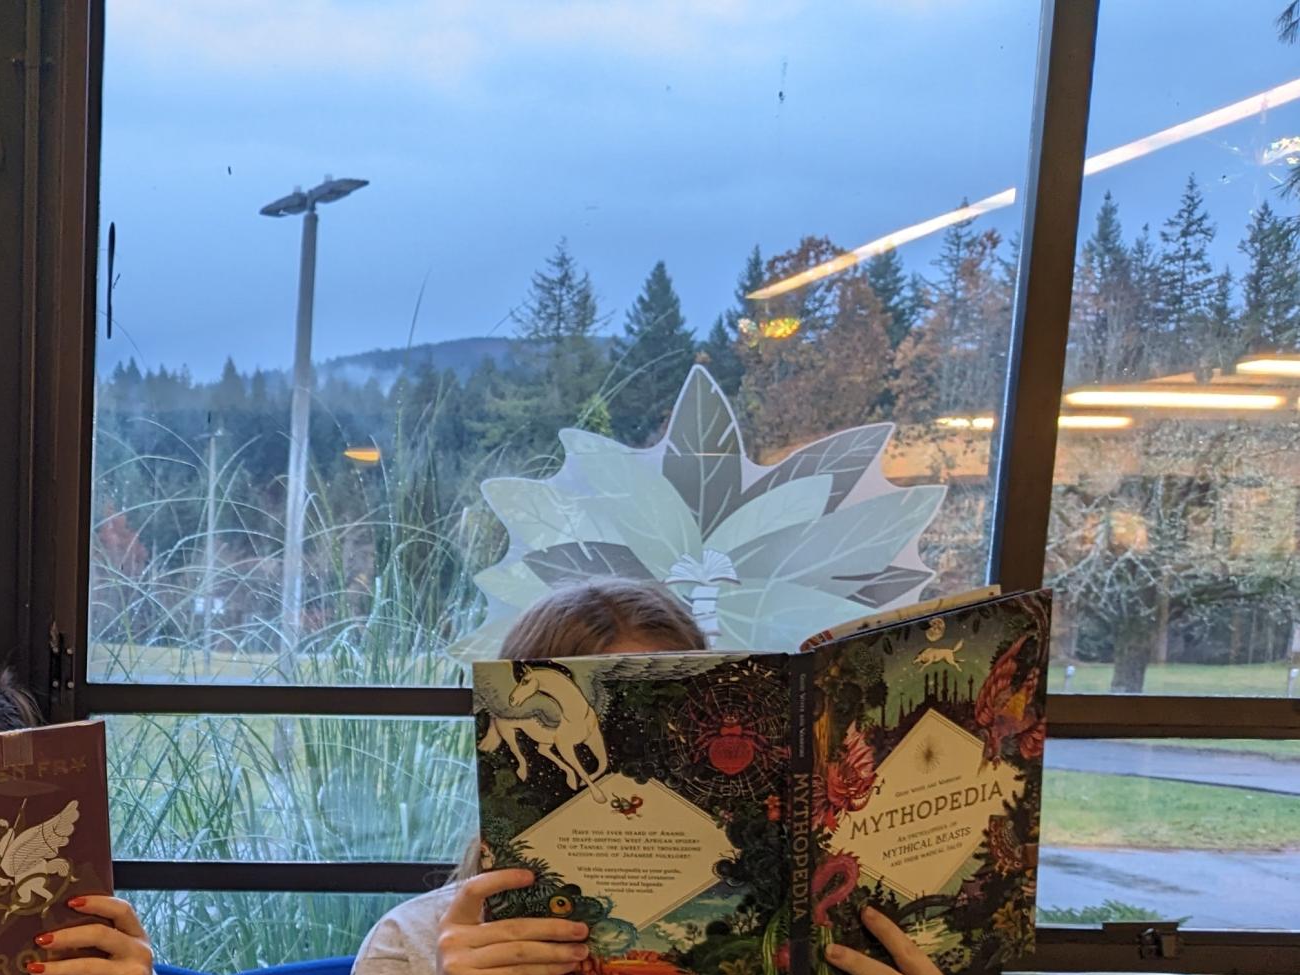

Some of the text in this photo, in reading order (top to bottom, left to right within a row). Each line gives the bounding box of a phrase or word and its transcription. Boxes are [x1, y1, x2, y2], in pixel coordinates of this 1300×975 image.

[38, 755, 87, 777] FRY
[850, 780, 1003, 840] MYTHOPEDIA
[792, 773, 809, 923] MYTHOPEDIA
[881, 826, 972, 860] MYTHICAL BEASTS
